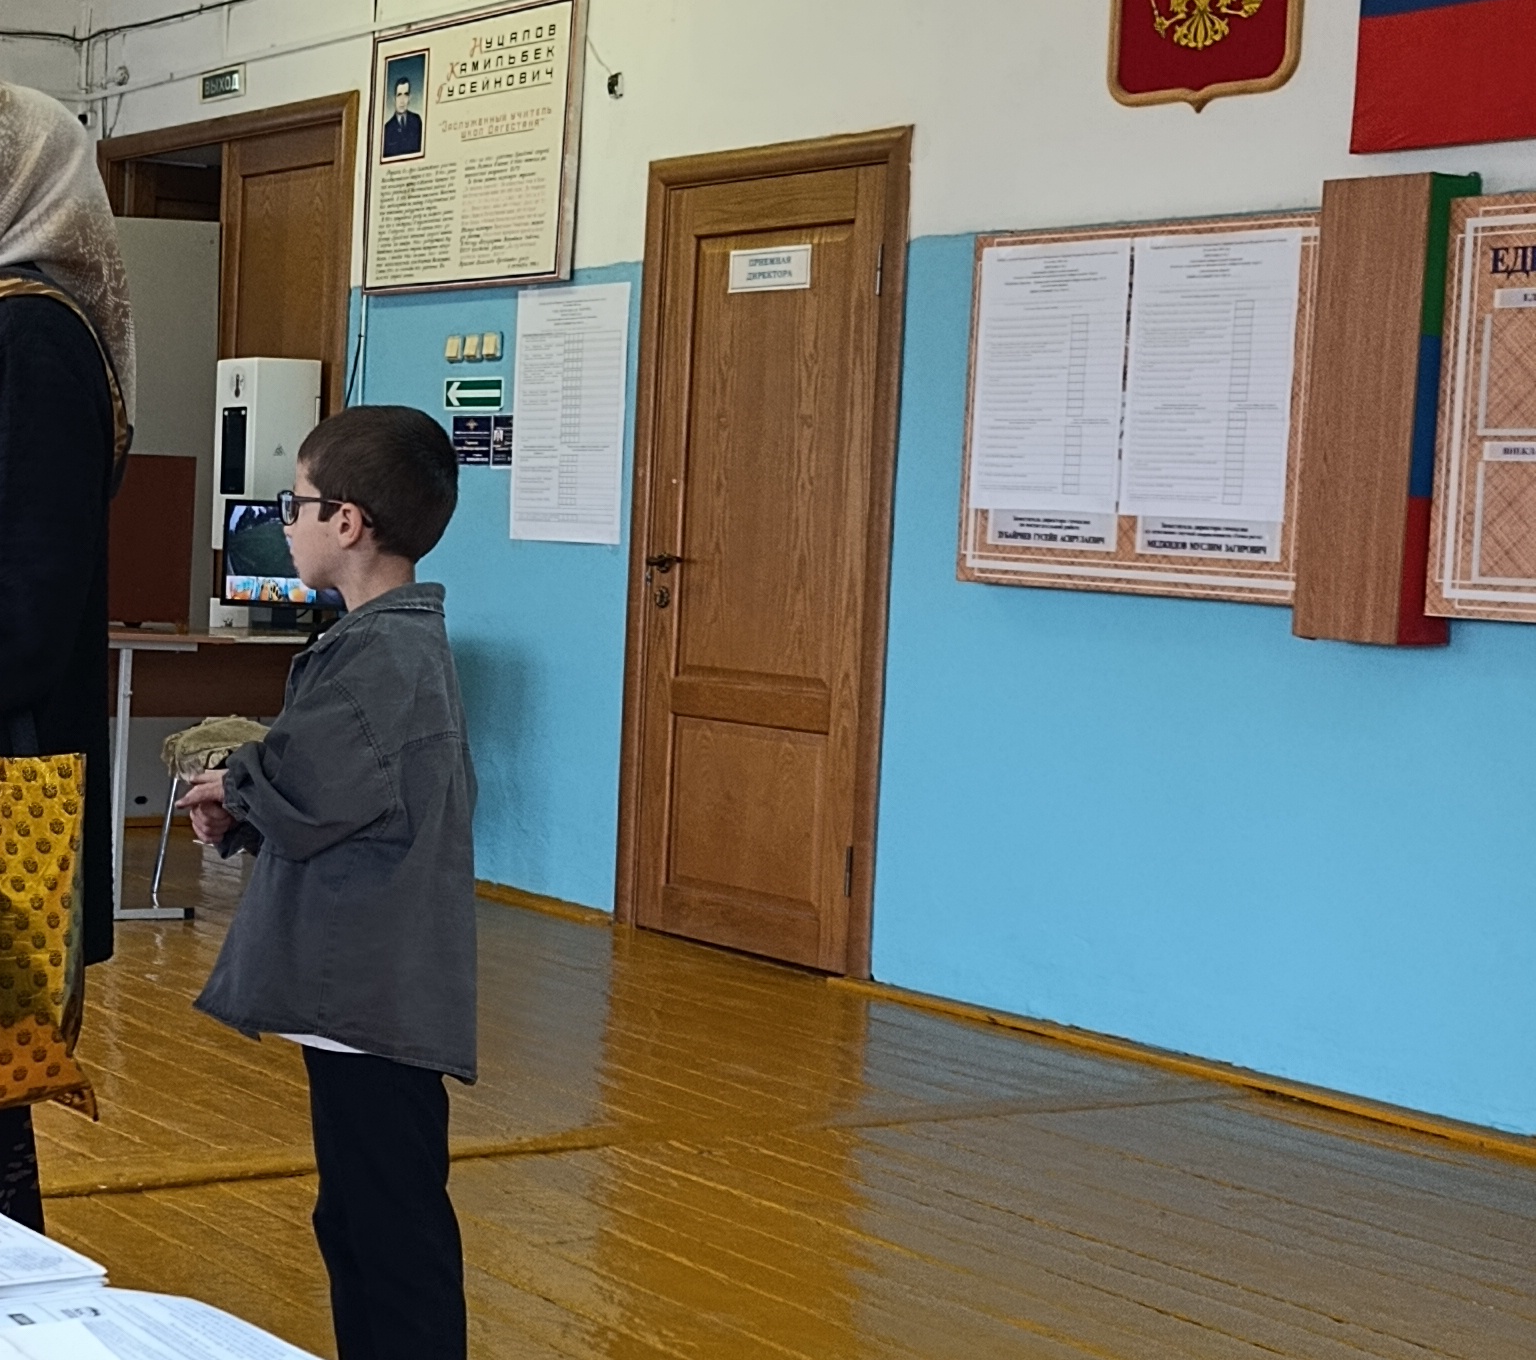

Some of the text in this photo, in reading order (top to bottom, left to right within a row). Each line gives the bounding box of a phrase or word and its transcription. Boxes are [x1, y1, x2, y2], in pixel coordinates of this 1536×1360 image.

[469, 24, 556, 58] НУЦАЛОВ
[446, 46, 555, 81] КАМИЛЬБЕК
[204, 73, 239, 96] ВЫХОД
[435, 67, 553, 104] ГУСЕЙНОВИЧ
[746, 270, 793, 281] ДИРЕКТОРА
